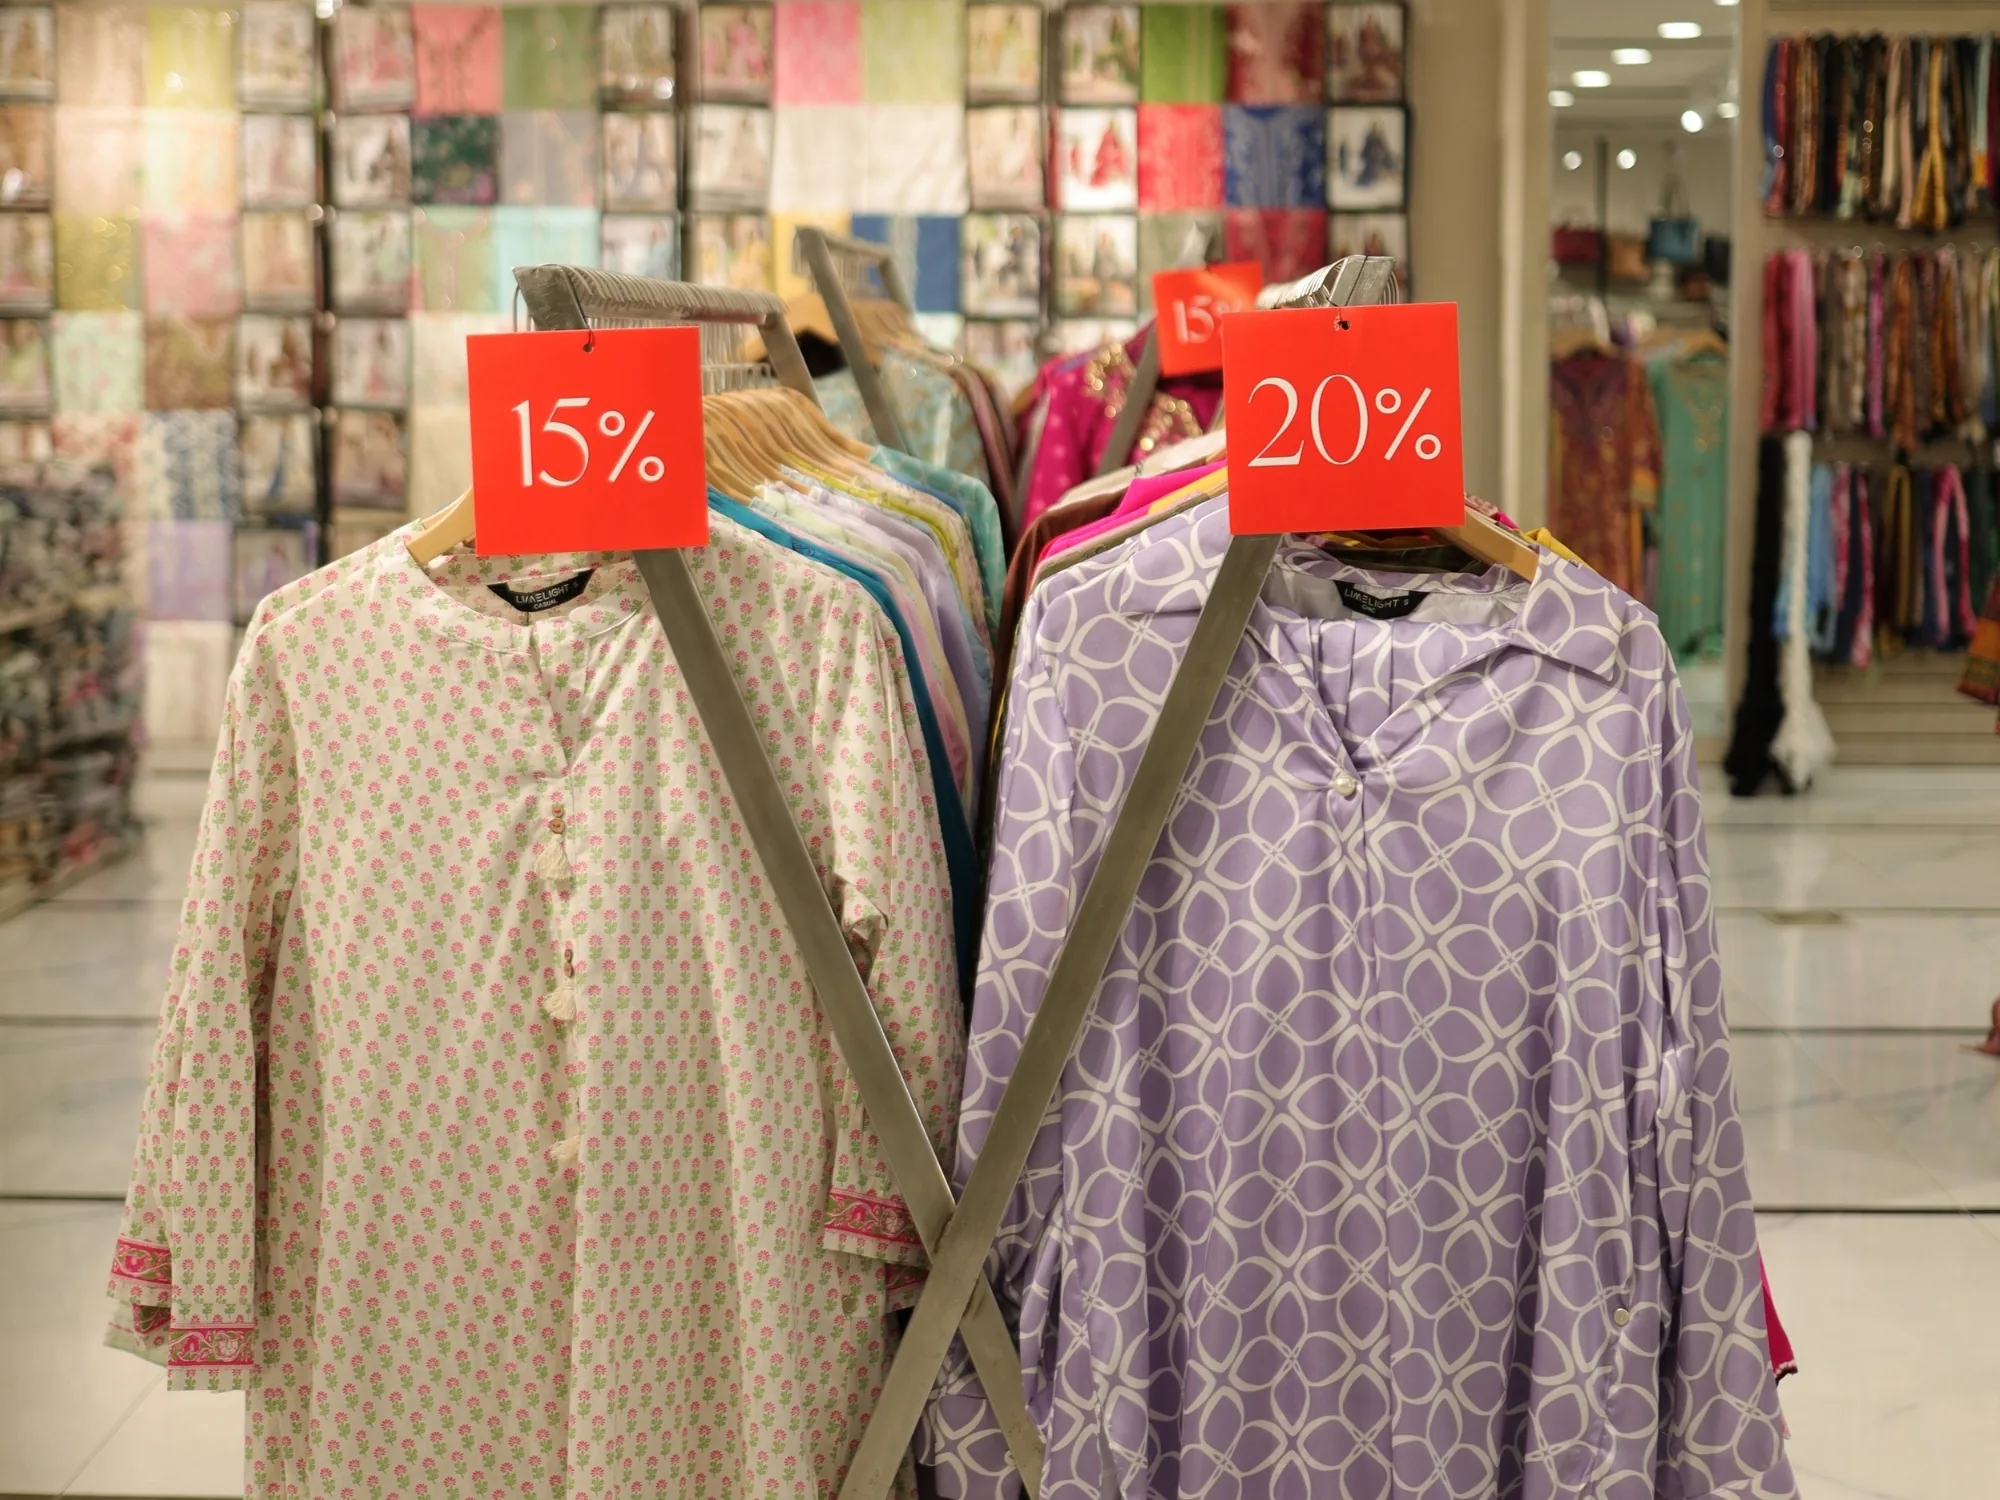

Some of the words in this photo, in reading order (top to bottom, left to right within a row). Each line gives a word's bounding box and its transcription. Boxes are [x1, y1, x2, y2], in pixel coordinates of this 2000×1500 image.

[1248, 374, 1441, 467] 20%
[511, 397, 665, 487] 15%
[515, 583, 570, 604] LIMELIGHT
[1344, 588, 1400, 608] LIMELIGHT
[533, 599, 558, 610] CASUAL
